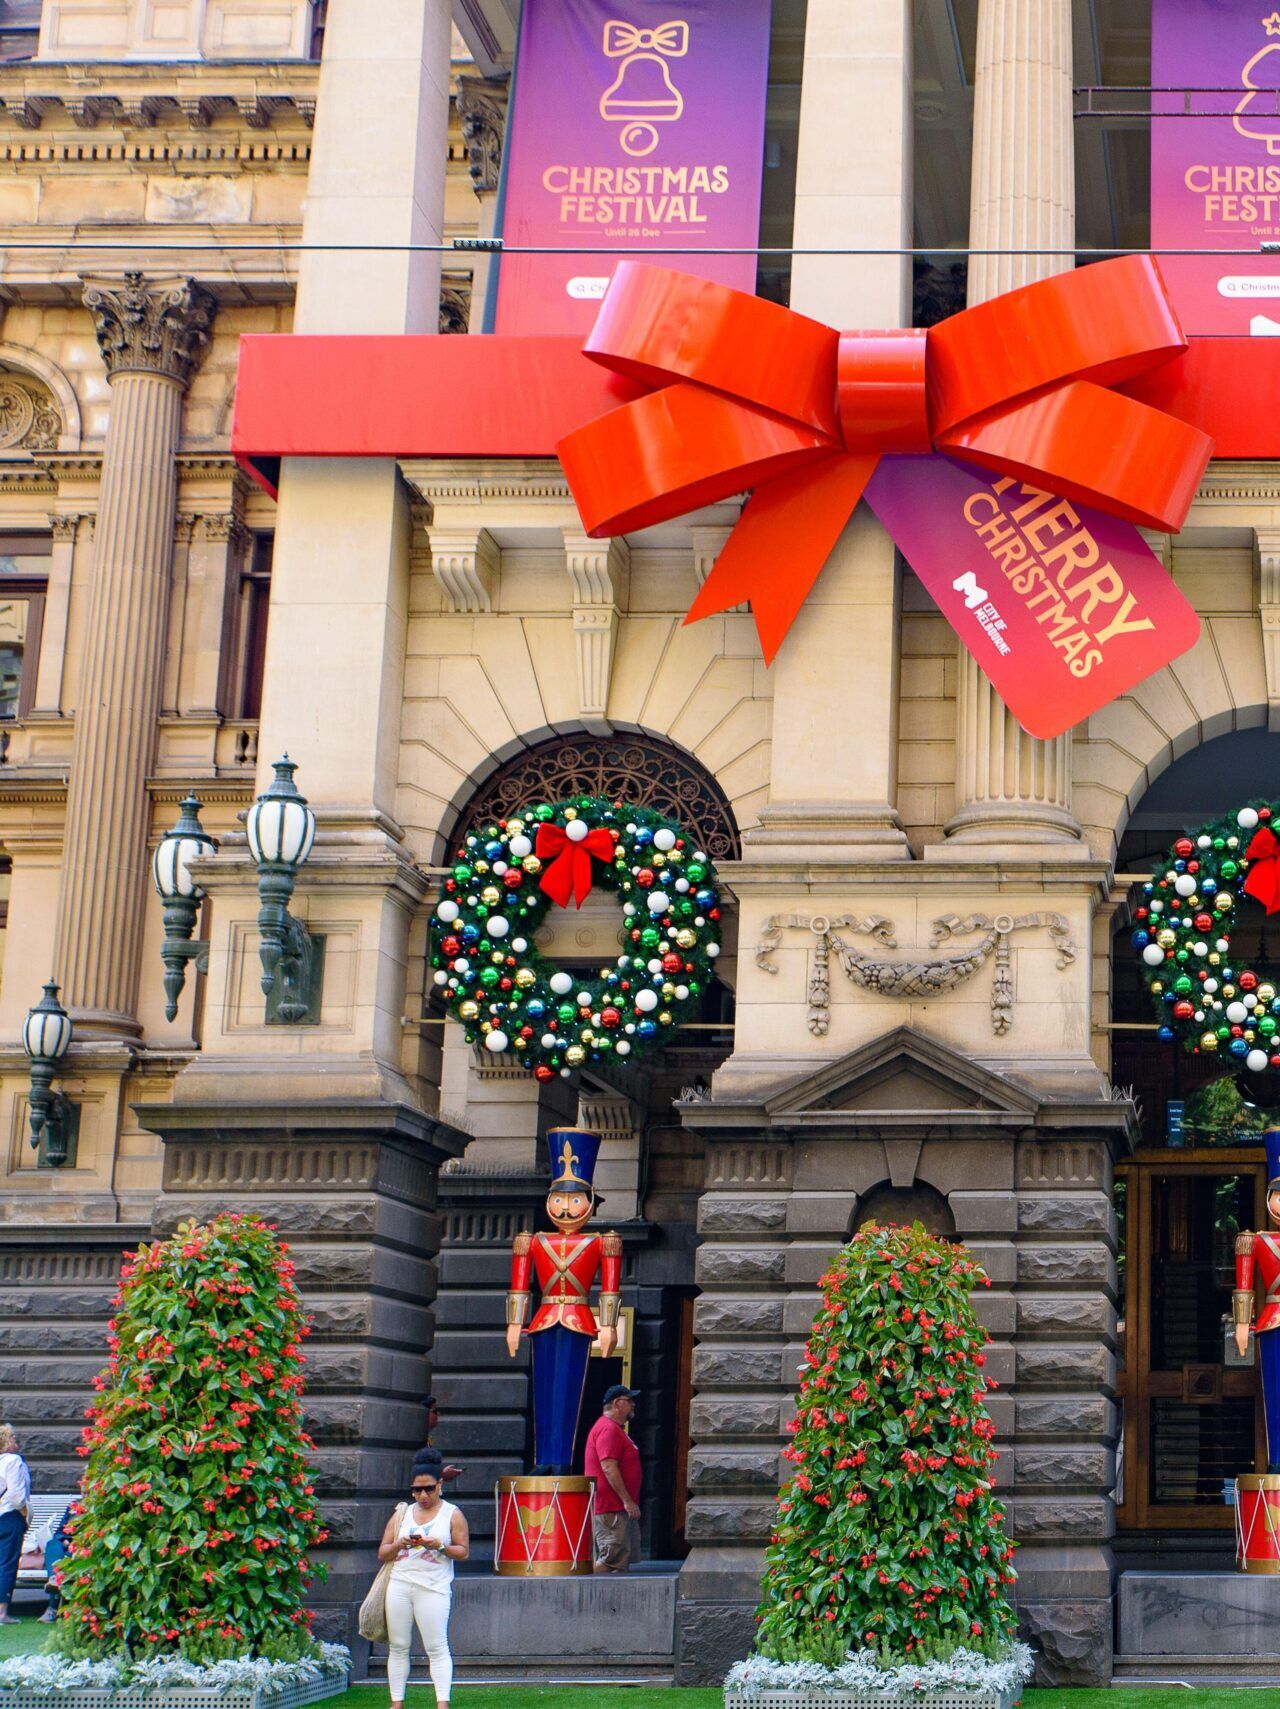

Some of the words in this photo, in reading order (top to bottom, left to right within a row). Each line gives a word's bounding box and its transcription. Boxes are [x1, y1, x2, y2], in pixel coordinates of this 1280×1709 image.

[542, 165, 729, 194] CHRISTMAS
[560, 195, 708, 223] FESTIVAL
[605, 227, 626, 237] Until
[1251, 226, 1272, 235] Until
[990, 475, 1156, 645] MERRY
[963, 492, 1104, 678] CHRISTMAS
[982, 602, 1000, 621] CITY
[994, 618, 1008, 631] OF
[973, 607, 1012, 656] MELBOURNE
